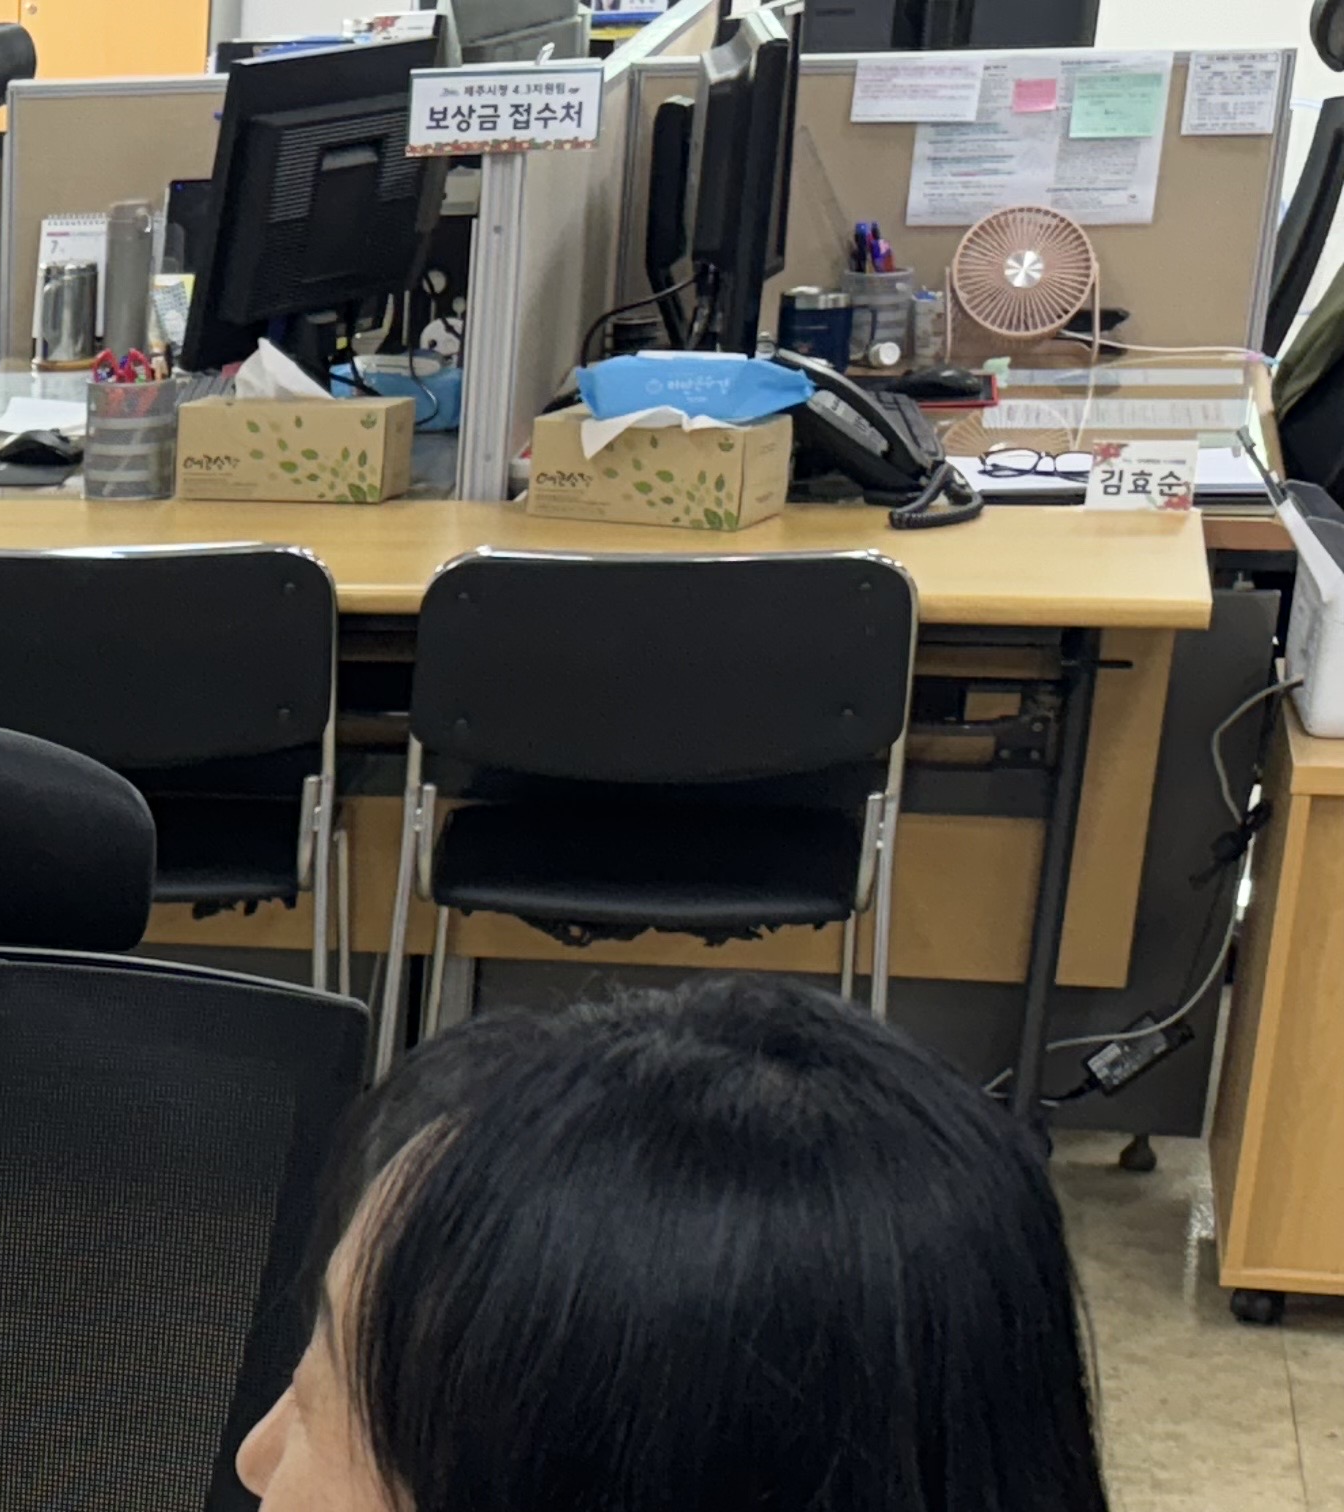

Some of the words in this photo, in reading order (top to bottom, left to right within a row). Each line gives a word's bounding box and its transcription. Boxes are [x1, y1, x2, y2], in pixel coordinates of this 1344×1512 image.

[426, 103, 500, 132] 보상금
[509, 101, 582, 129] 접수처
[1101, 470, 1184, 497] 김효순
